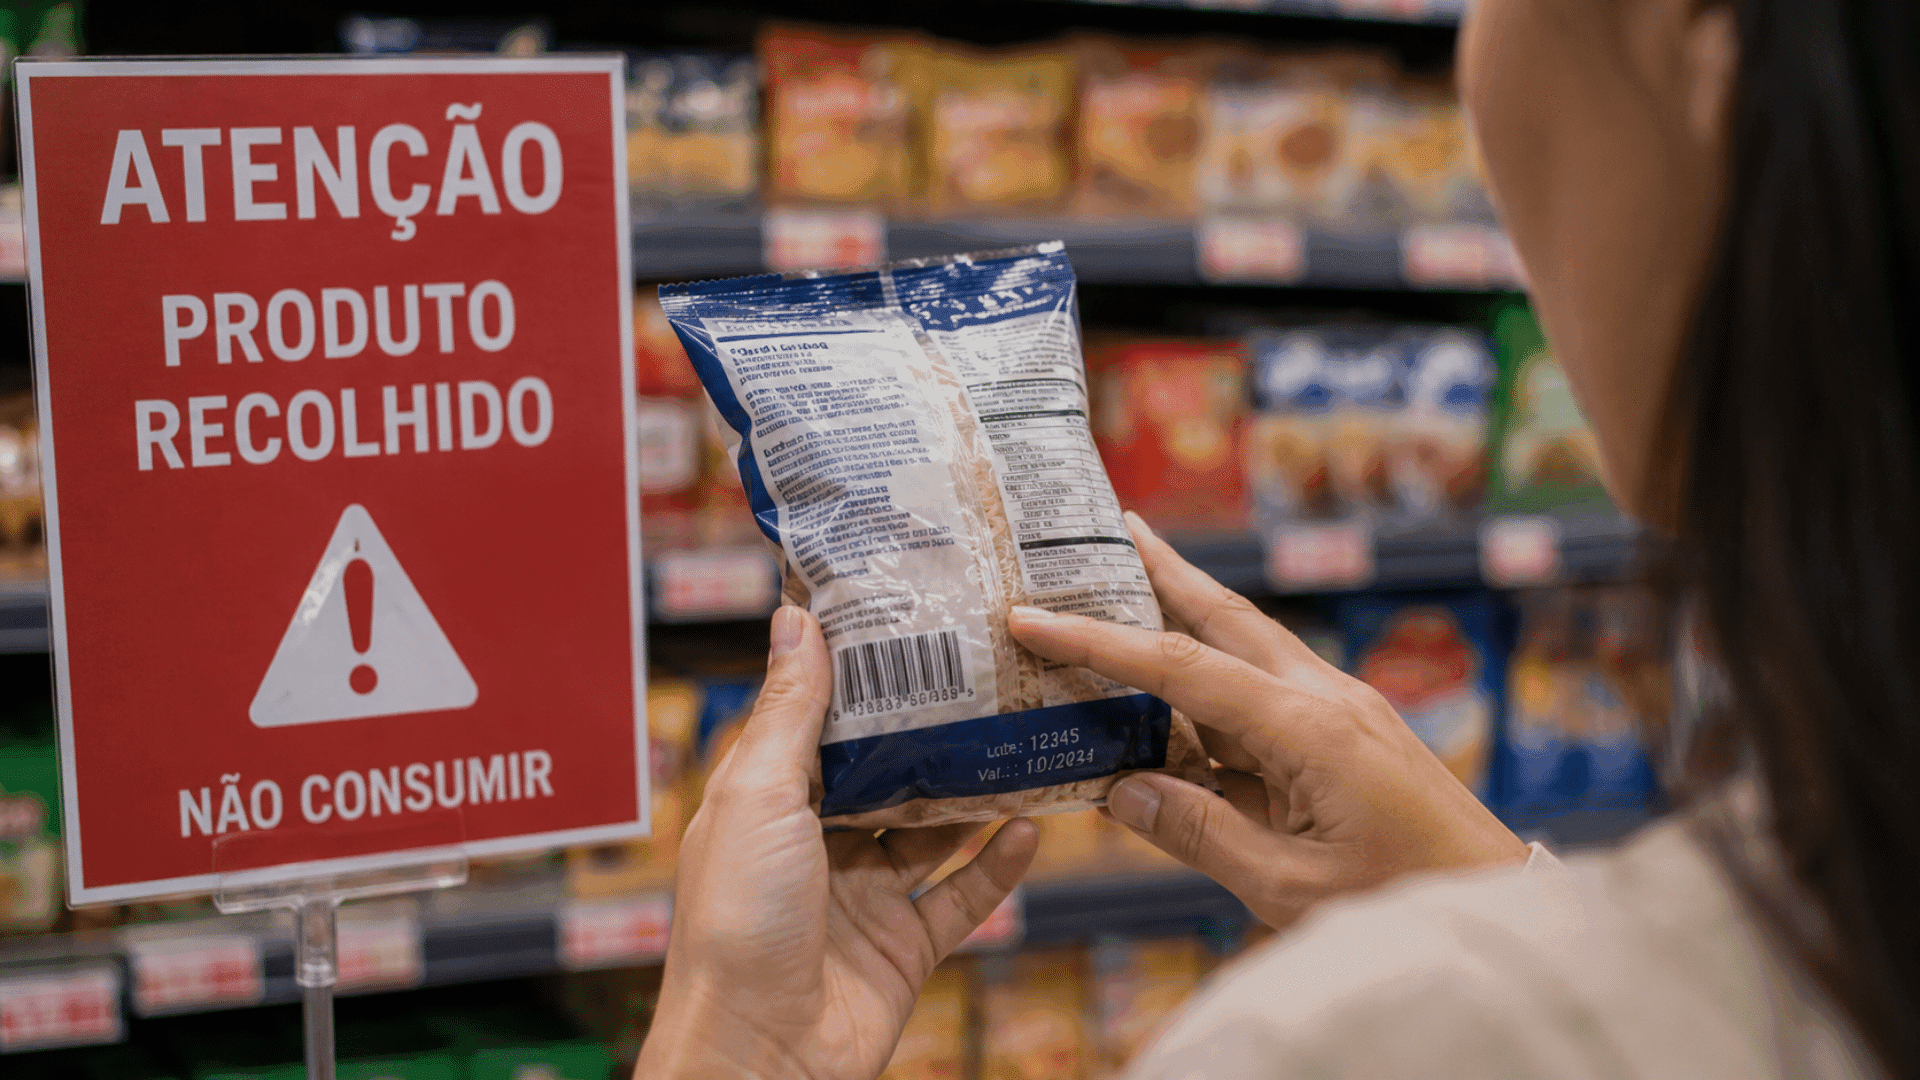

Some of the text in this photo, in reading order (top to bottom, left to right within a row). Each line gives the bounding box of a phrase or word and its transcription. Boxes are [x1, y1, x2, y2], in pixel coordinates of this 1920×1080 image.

[100, 103, 564, 241] ATENÇÃO
[162, 280, 516, 367] PRODUTO
[135, 377, 555, 471] RECOLHIDO
[1030, 727, 1080, 752] 12345
[179, 750, 554, 837] NÃO CONSUMIR
